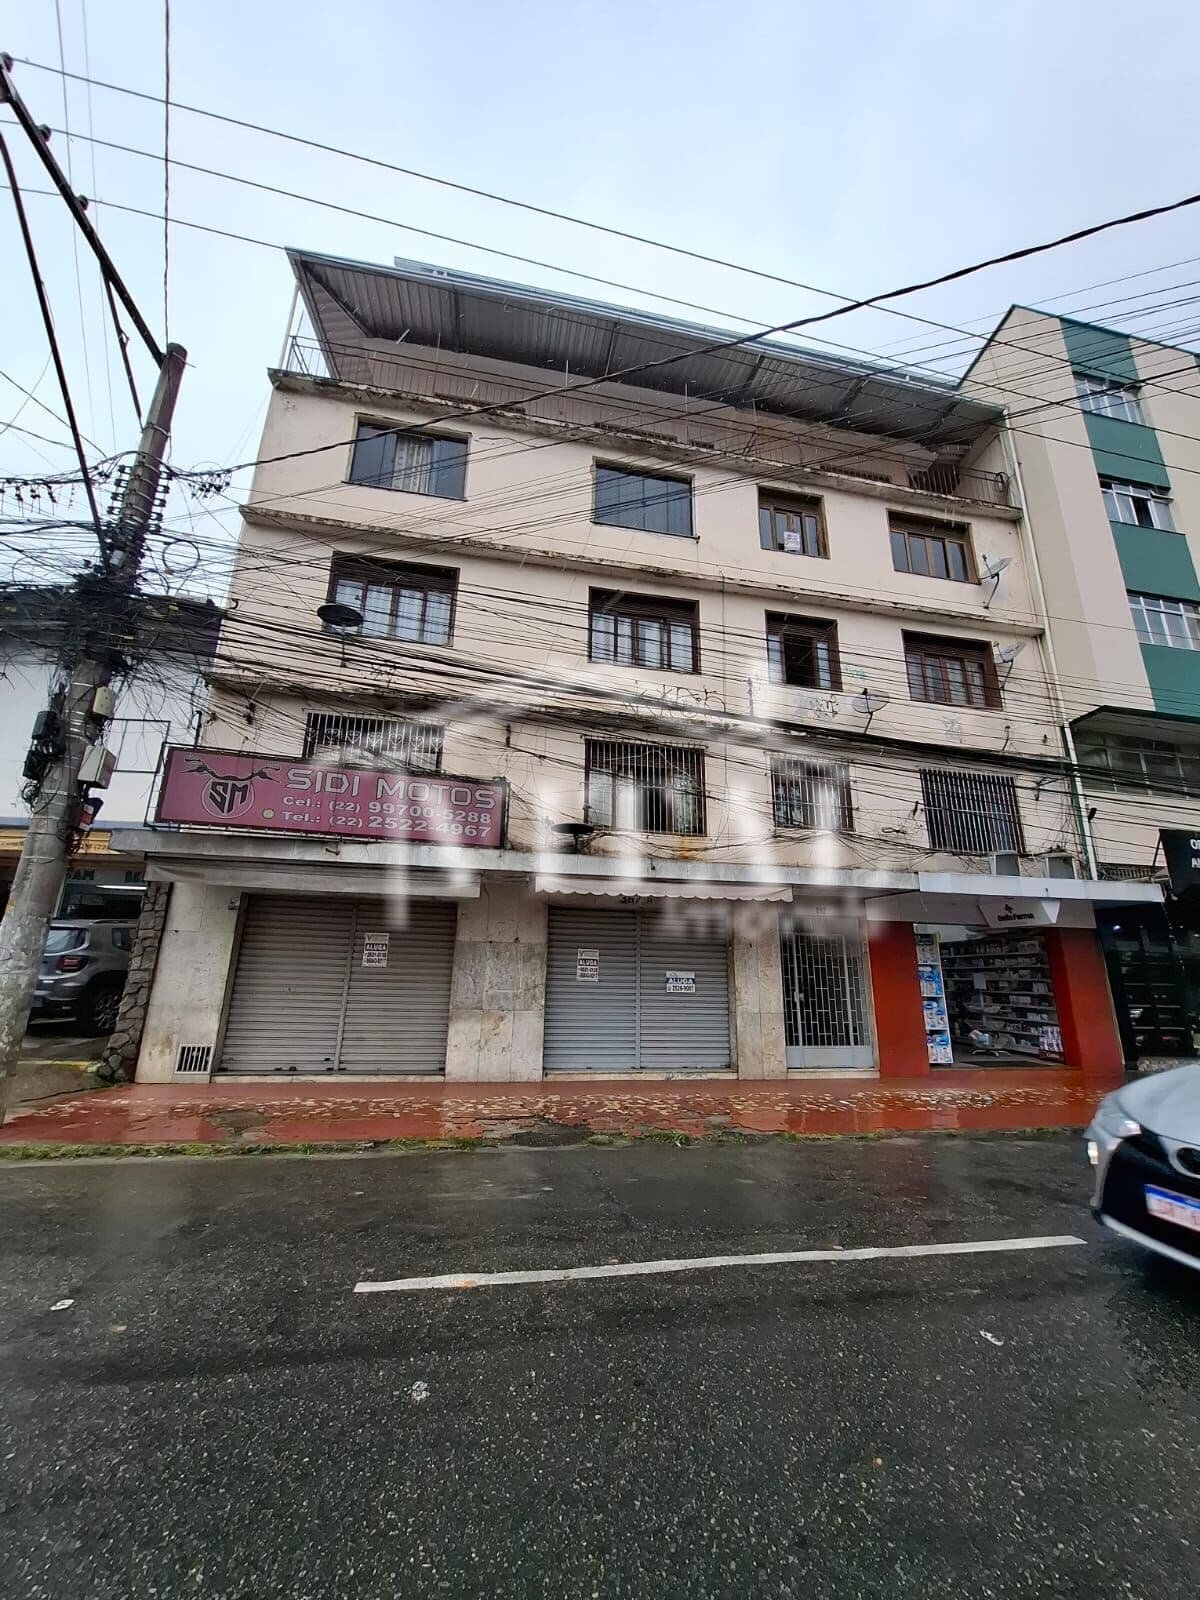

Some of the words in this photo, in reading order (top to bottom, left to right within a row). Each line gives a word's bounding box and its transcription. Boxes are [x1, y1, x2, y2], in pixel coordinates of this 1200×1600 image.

[286, 767, 360, 797] SIDI
[376, 776, 497, 809] MOTOS
[329, 800, 360, 813] (22)
[282, 811, 321, 823] Tel.:
[329, 816, 363, 828] (22)
[366, 943, 388, 951] ALUGA
[668, 977, 694, 985] ALUGA
